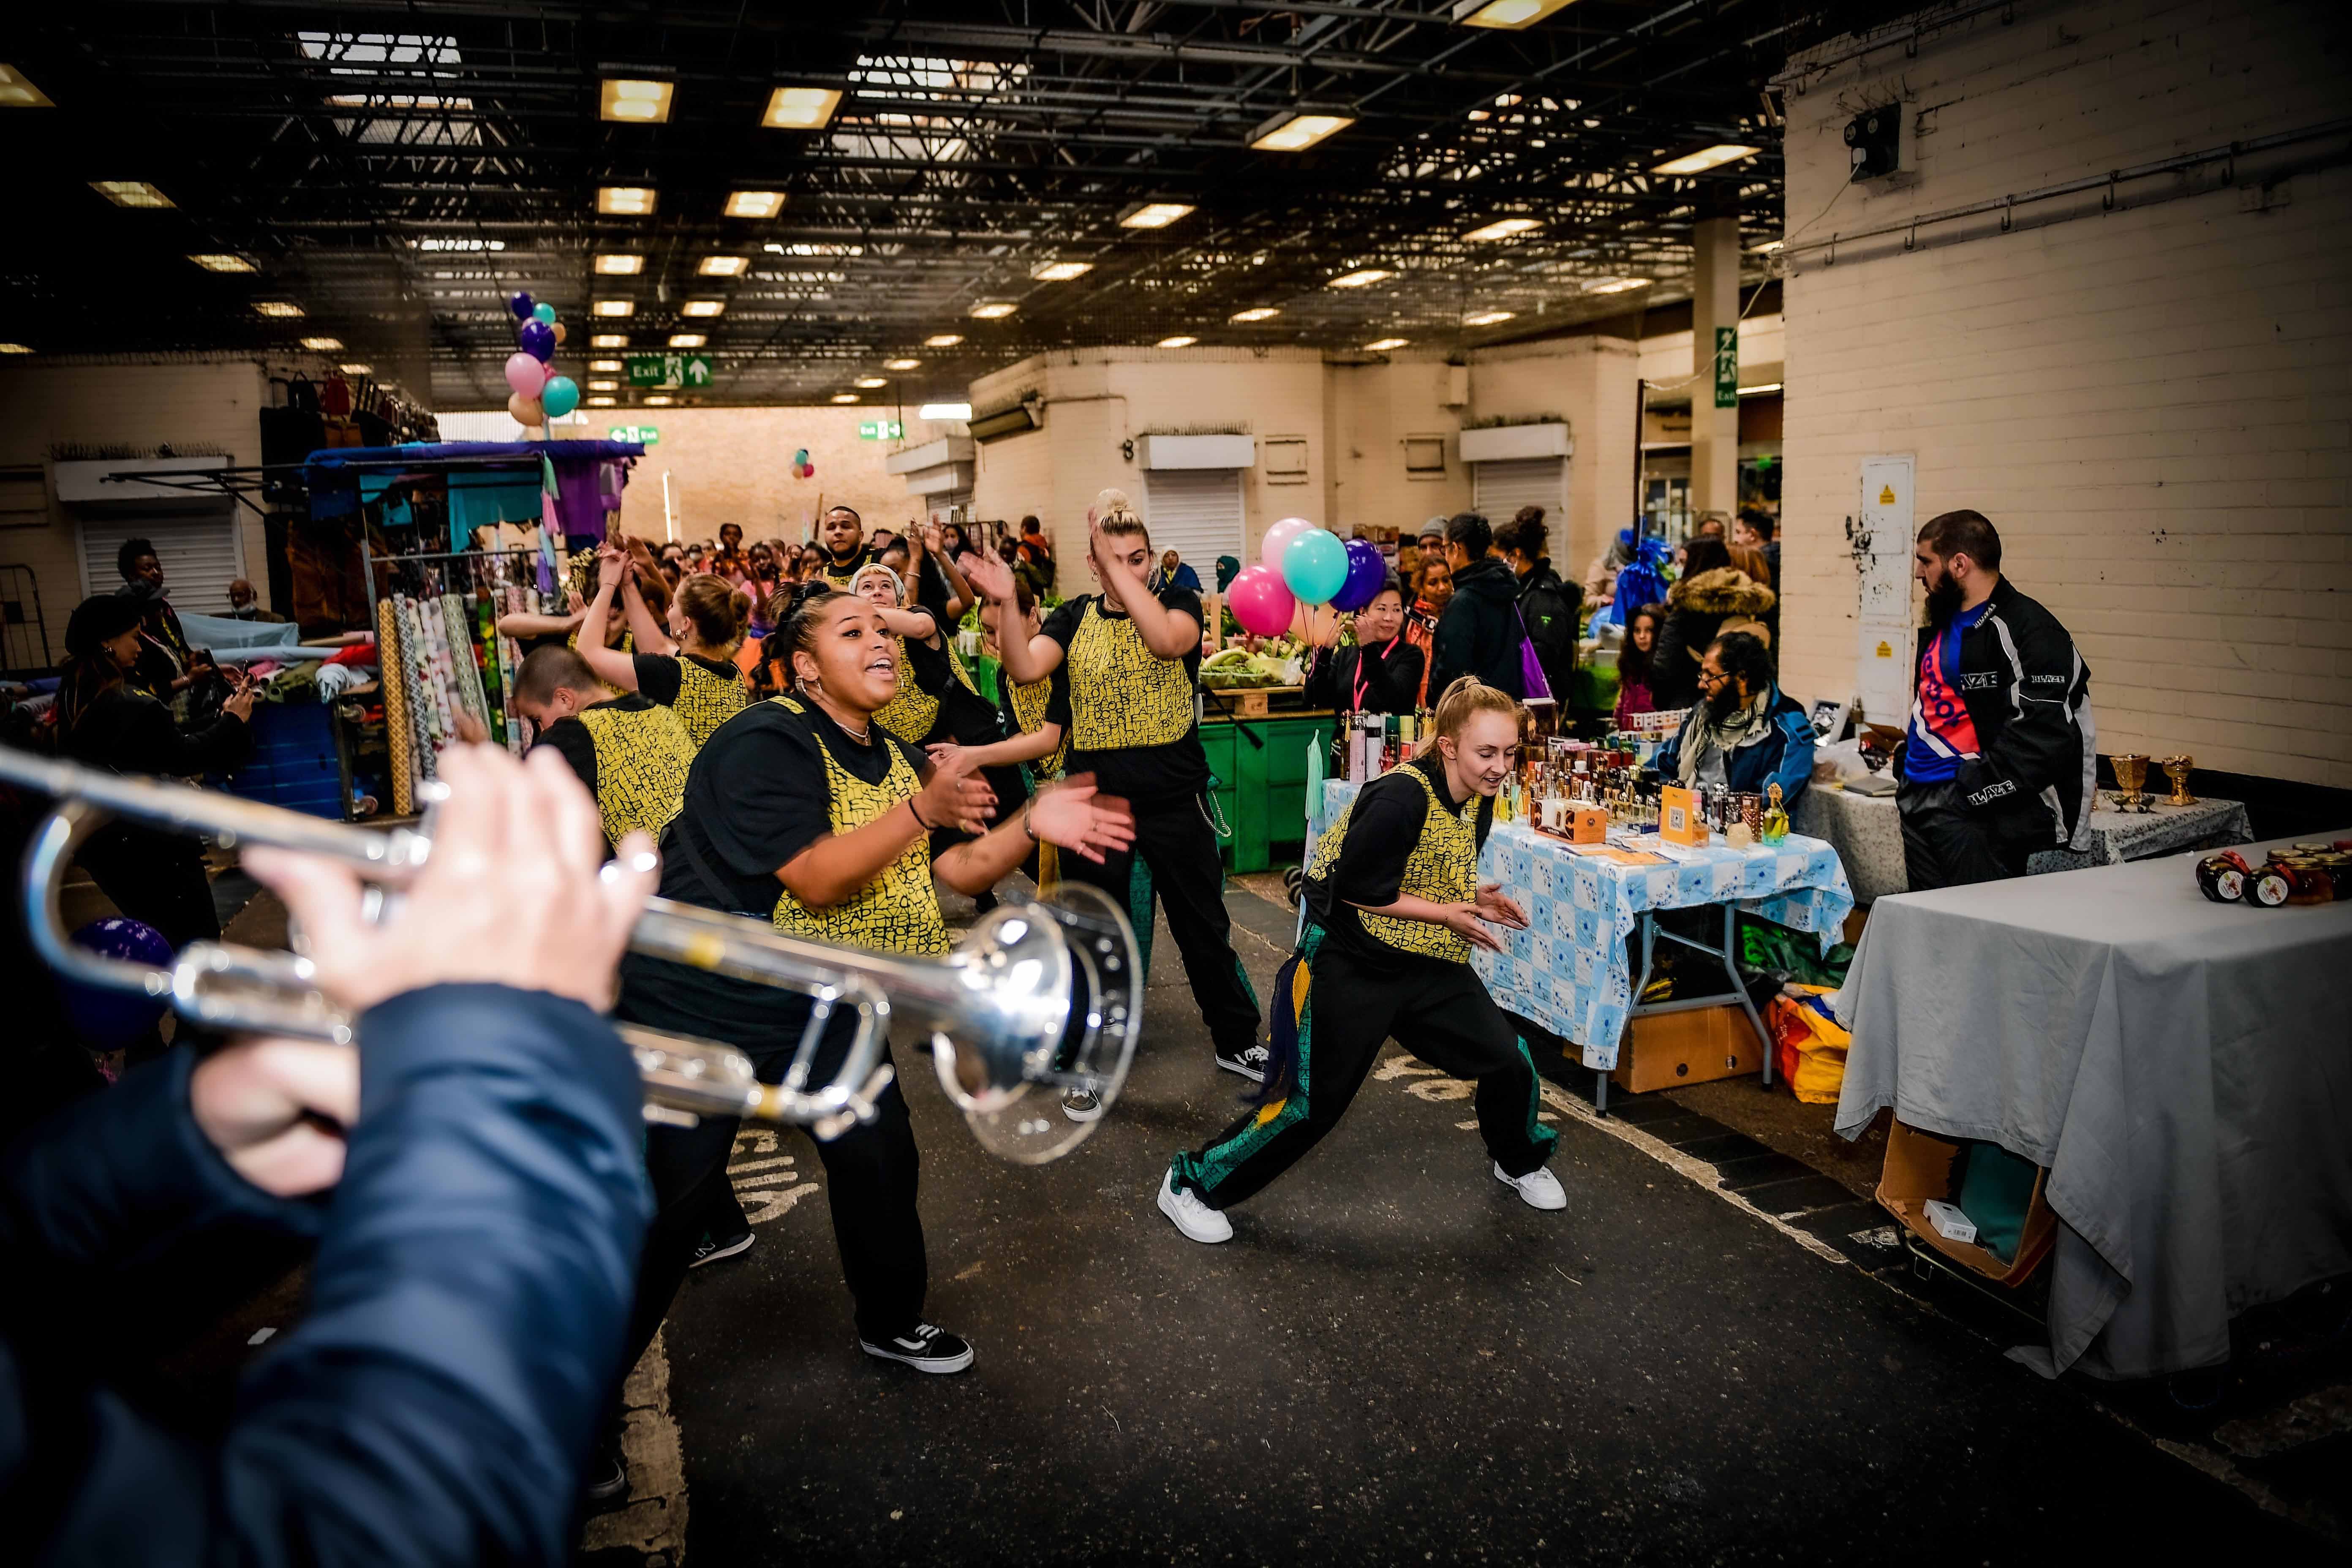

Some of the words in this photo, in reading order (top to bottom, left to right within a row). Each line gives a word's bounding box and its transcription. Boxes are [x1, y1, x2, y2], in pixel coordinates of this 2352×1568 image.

[633, 365, 659, 378] Exit
[1717, 390, 1735, 401] Exit
[640, 430, 657, 440] Exit
[2031, 675, 2065, 683] BLAZE
